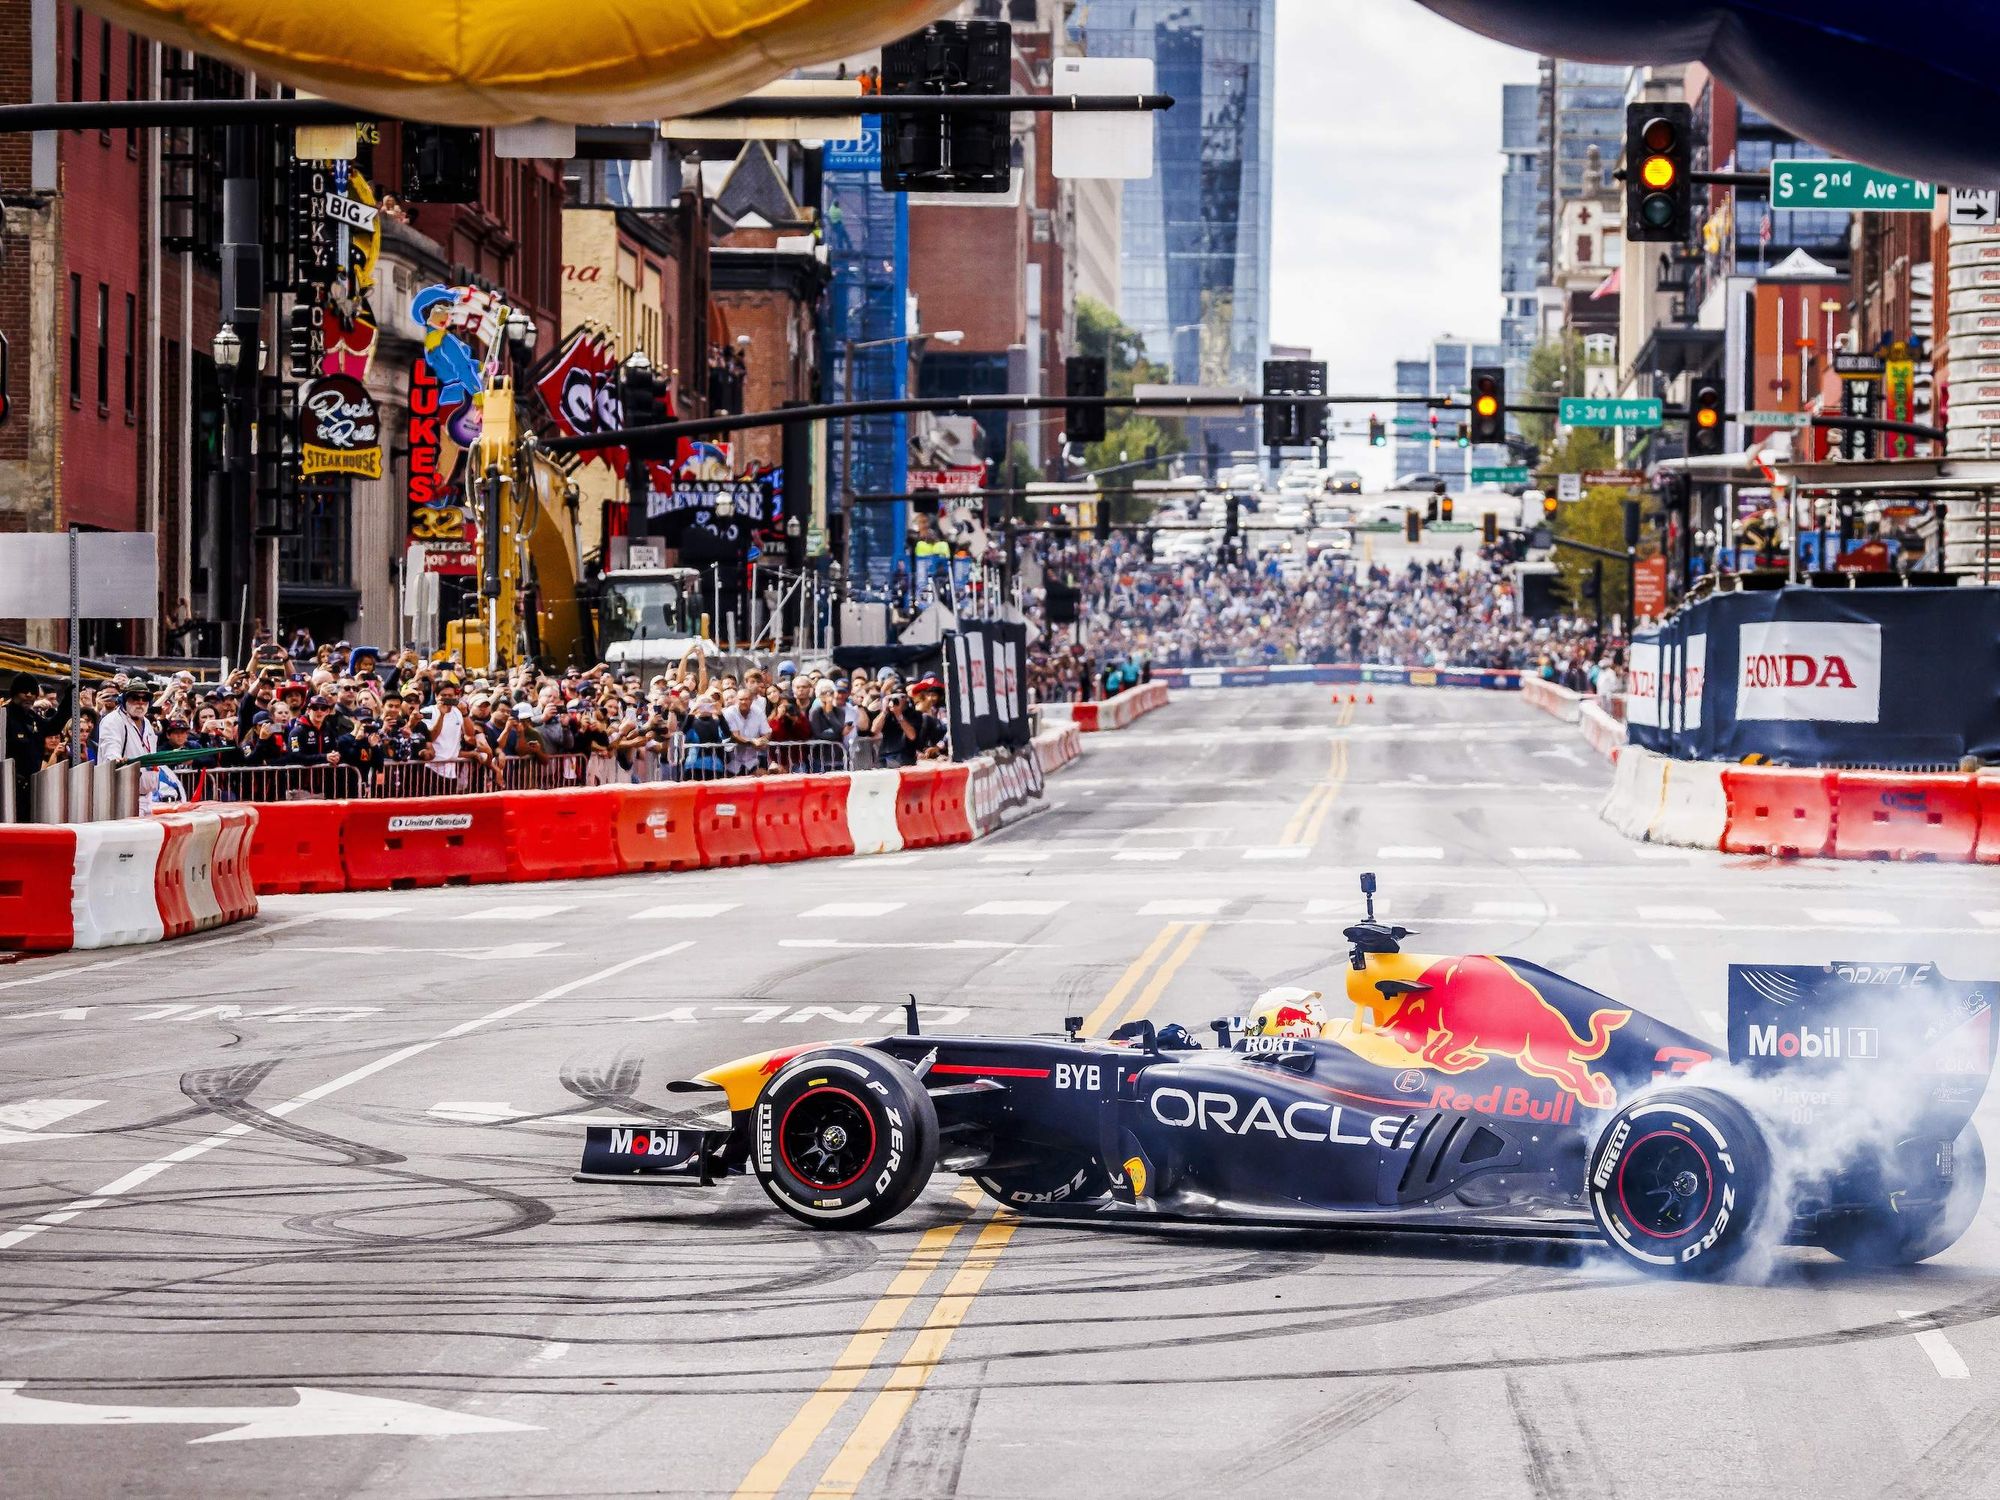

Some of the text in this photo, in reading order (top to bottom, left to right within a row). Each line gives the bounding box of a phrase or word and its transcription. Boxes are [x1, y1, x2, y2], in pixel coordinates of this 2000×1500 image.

[330, 196, 361, 223] BIG
[308, 390, 374, 422] Rock
[409, 358, 443, 503] LUKE'S
[306, 449, 377, 473] STEAKHOUSE
[411, 506, 464, 538] 32
[1745, 654, 1858, 689] HONDA
[404, 819, 433, 827] United
[622, 1005, 972, 1025] ONLY
[1246, 1036, 1299, 1053] ROKT
[1749, 1025, 1841, 1058] Mobil
[1150, 1086, 1418, 1150] ORACLE
[1429, 1085, 1574, 1126] Red Bull
[608, 1128, 679, 1156] Mobil
[757, 1103, 772, 1172] PIRELLI
[866, 1080, 904, 1195] P ZERO
[1593, 1119, 1632, 1190] PIRELLI
[1010, 1168, 1087, 1203] ZERO
[1681, 1152, 1735, 1263] P ZERO
